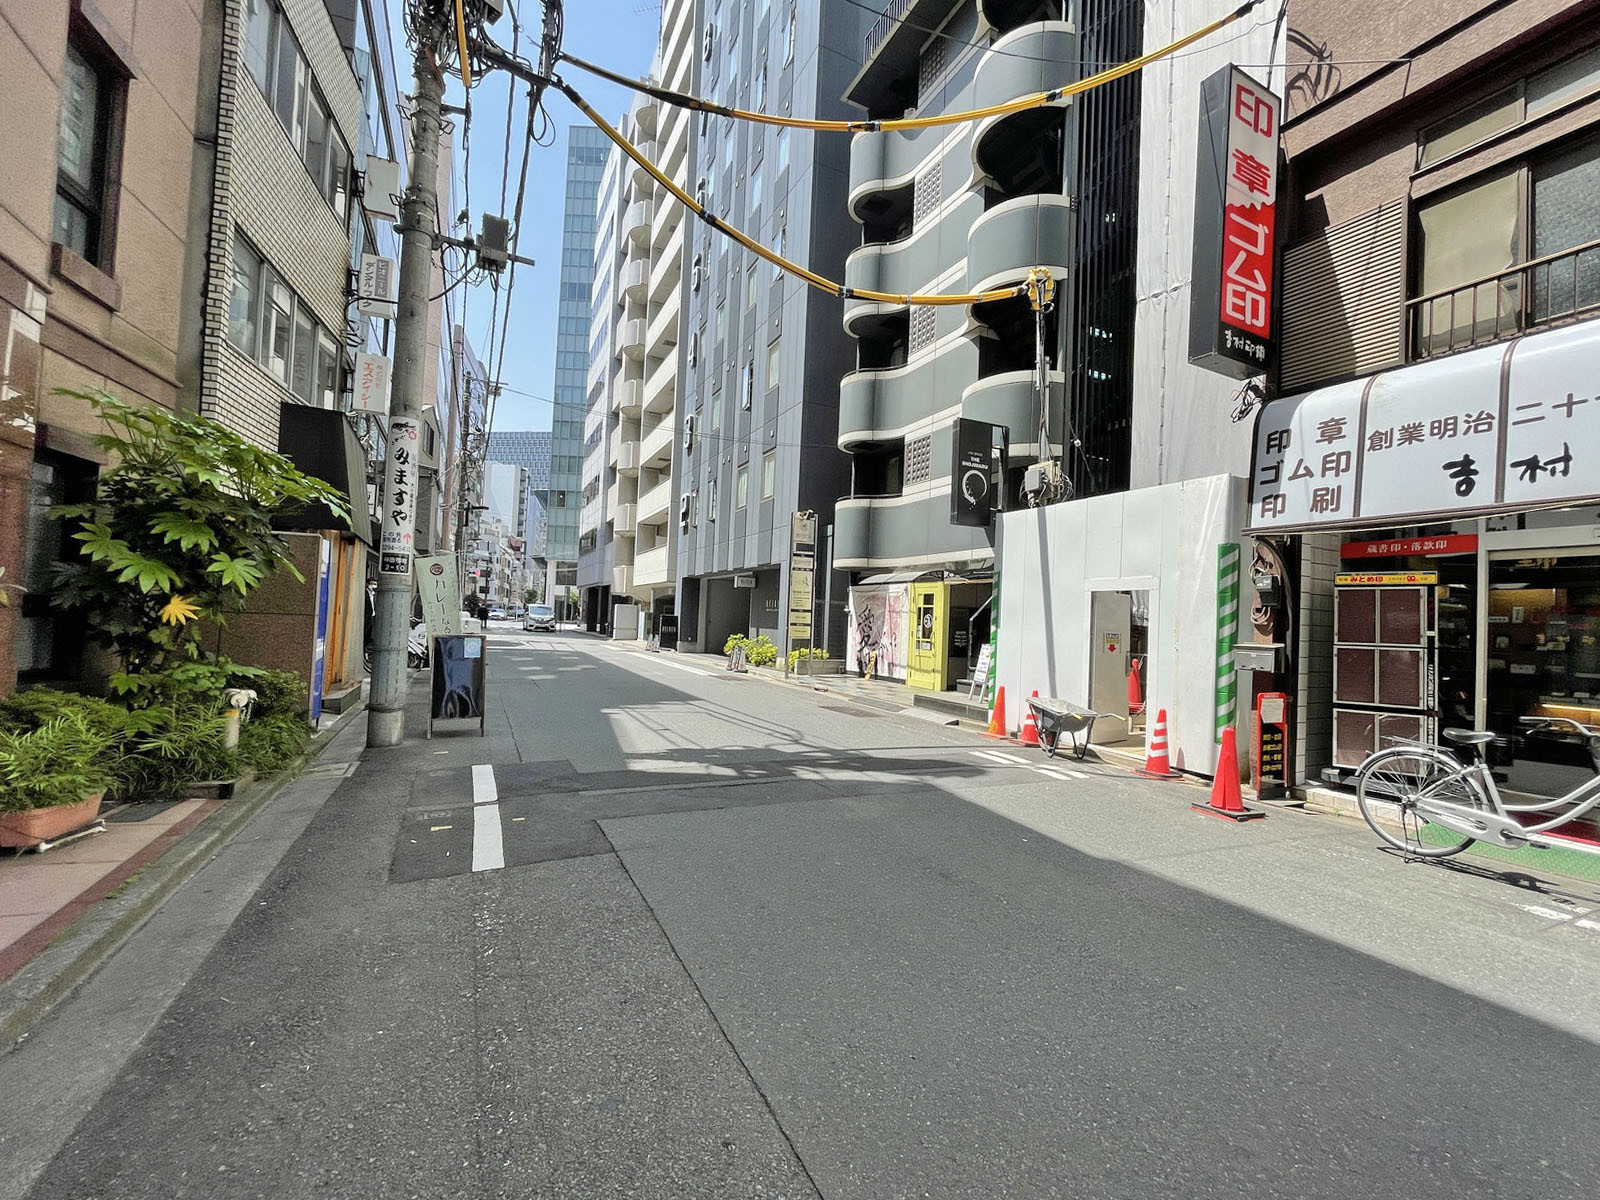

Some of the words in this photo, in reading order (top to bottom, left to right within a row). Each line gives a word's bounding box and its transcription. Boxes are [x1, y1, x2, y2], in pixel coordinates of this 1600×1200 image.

[1231, 83, 1273, 197] 印章
[1226, 211, 1269, 327] ゴム印
[1265, 416, 1348, 455] 印章
[1367, 392, 1600, 452] 創業明治二十
[391, 446, 410, 527] みますや
[1259, 450, 1351, 486] ゴム印
[1441, 442, 1573, 497] 吉村
[1260, 484, 1342, 518] 印刷
